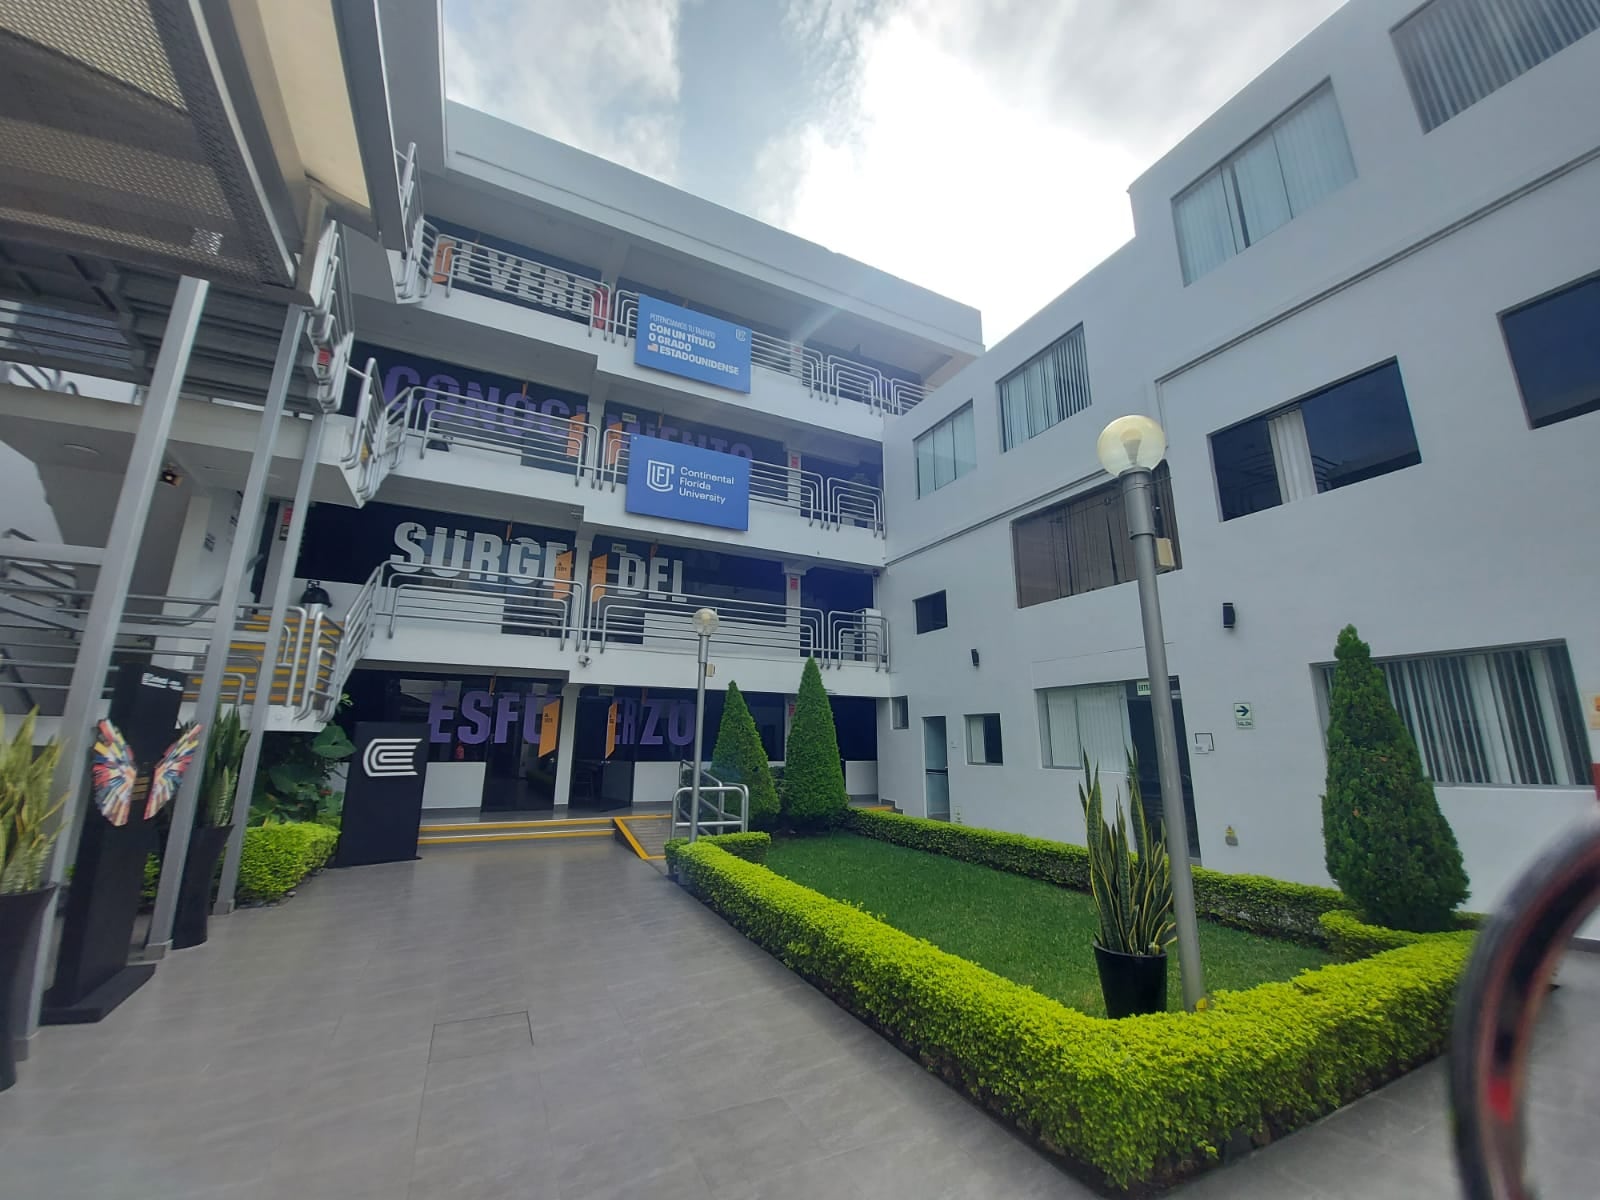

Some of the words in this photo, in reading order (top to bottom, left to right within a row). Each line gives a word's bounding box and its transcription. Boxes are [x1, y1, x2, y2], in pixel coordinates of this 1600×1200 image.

[648, 332, 656, 342] O
[657, 335, 692, 352] GRADO
[649, 322, 671, 337] CON
[672, 329, 685, 341] UN
[687, 333, 716, 349] TÍTULO
[659, 345, 740, 376] ESTADOUNIDENSE
[679, 477, 711, 491] Florida
[680, 466, 735, 485] Continental
[679, 487, 726, 505] University
